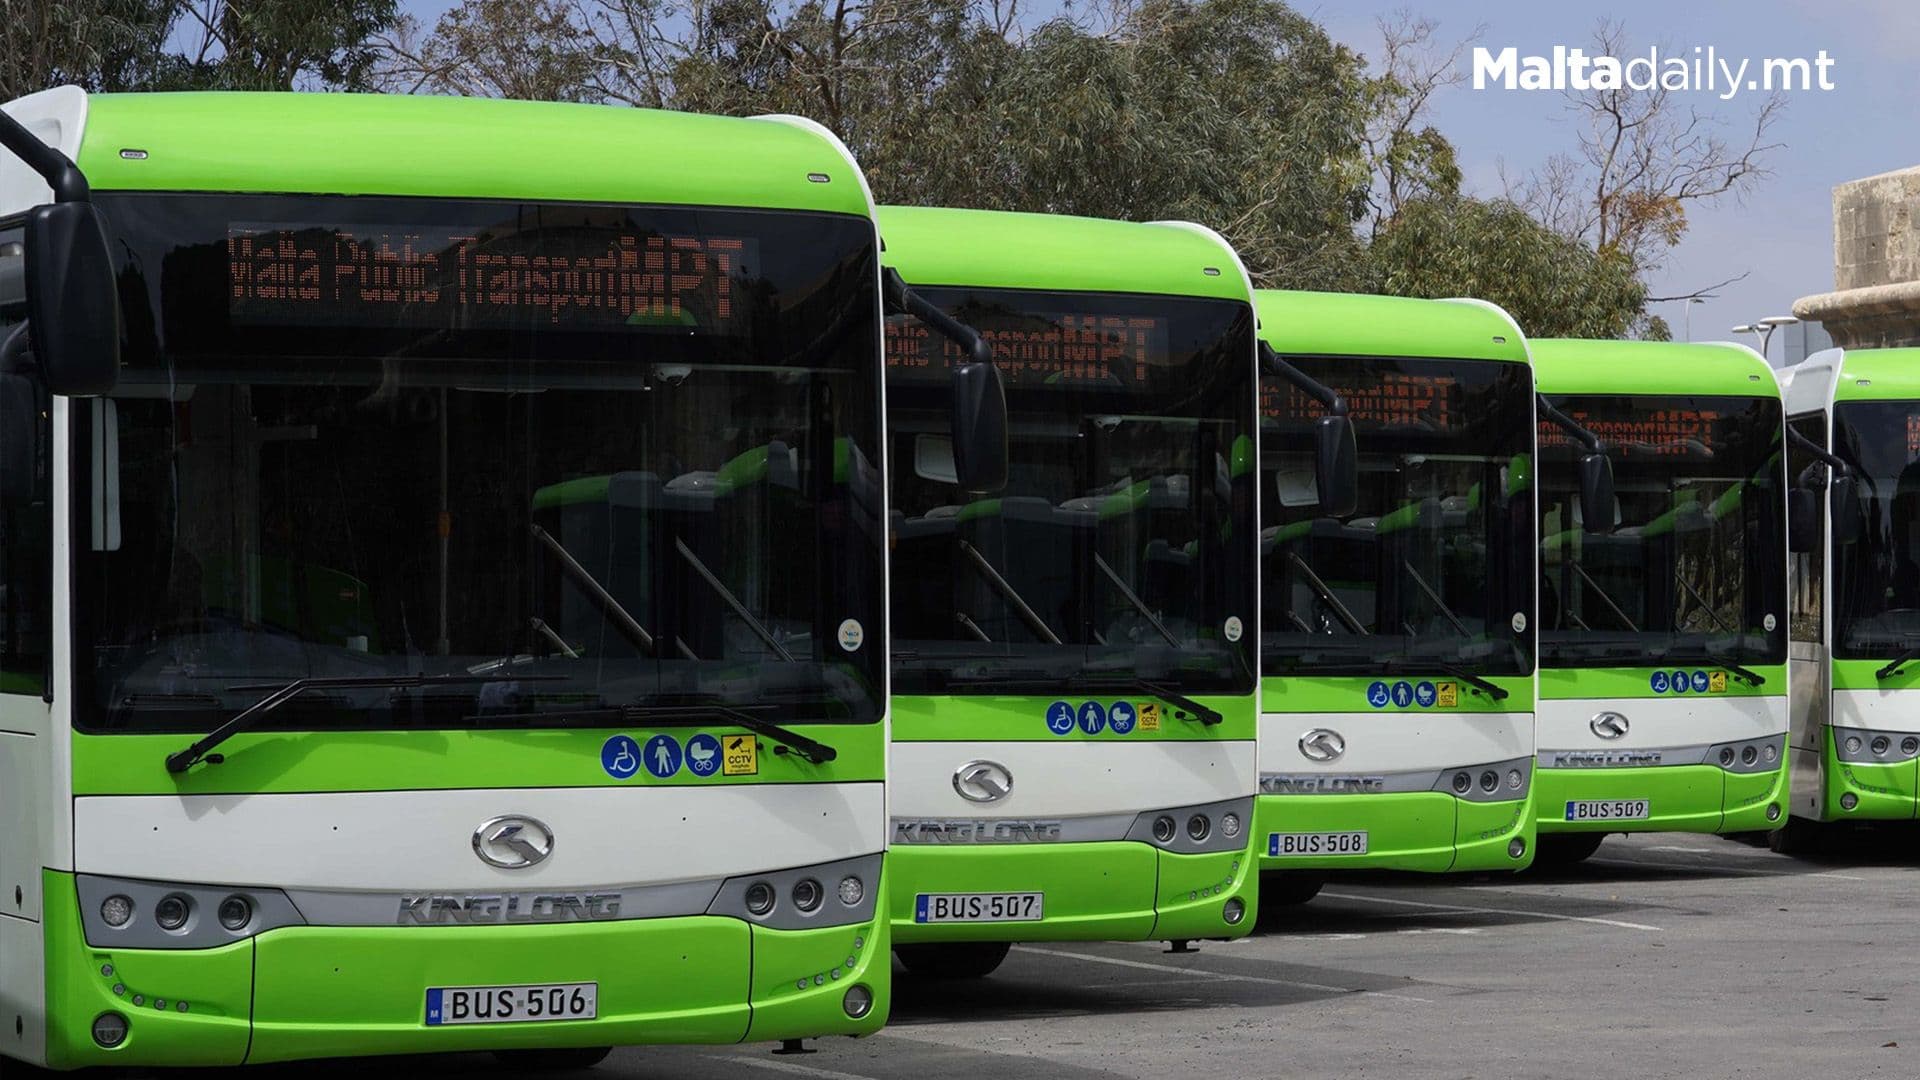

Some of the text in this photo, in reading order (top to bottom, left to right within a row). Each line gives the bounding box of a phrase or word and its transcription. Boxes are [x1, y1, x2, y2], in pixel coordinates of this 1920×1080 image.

[228, 229, 320, 298] Malta
[335, 233, 439, 302] Public
[728, 755, 752, 764] CCTV
[1578, 802, 1644, 818] BUS 509
[1284, 834, 1361, 853] BUS 508
[935, 896, 982, 918] BUS
[991, 896, 1035, 918] 507
[430, 987, 586, 1019] M BUS 506
